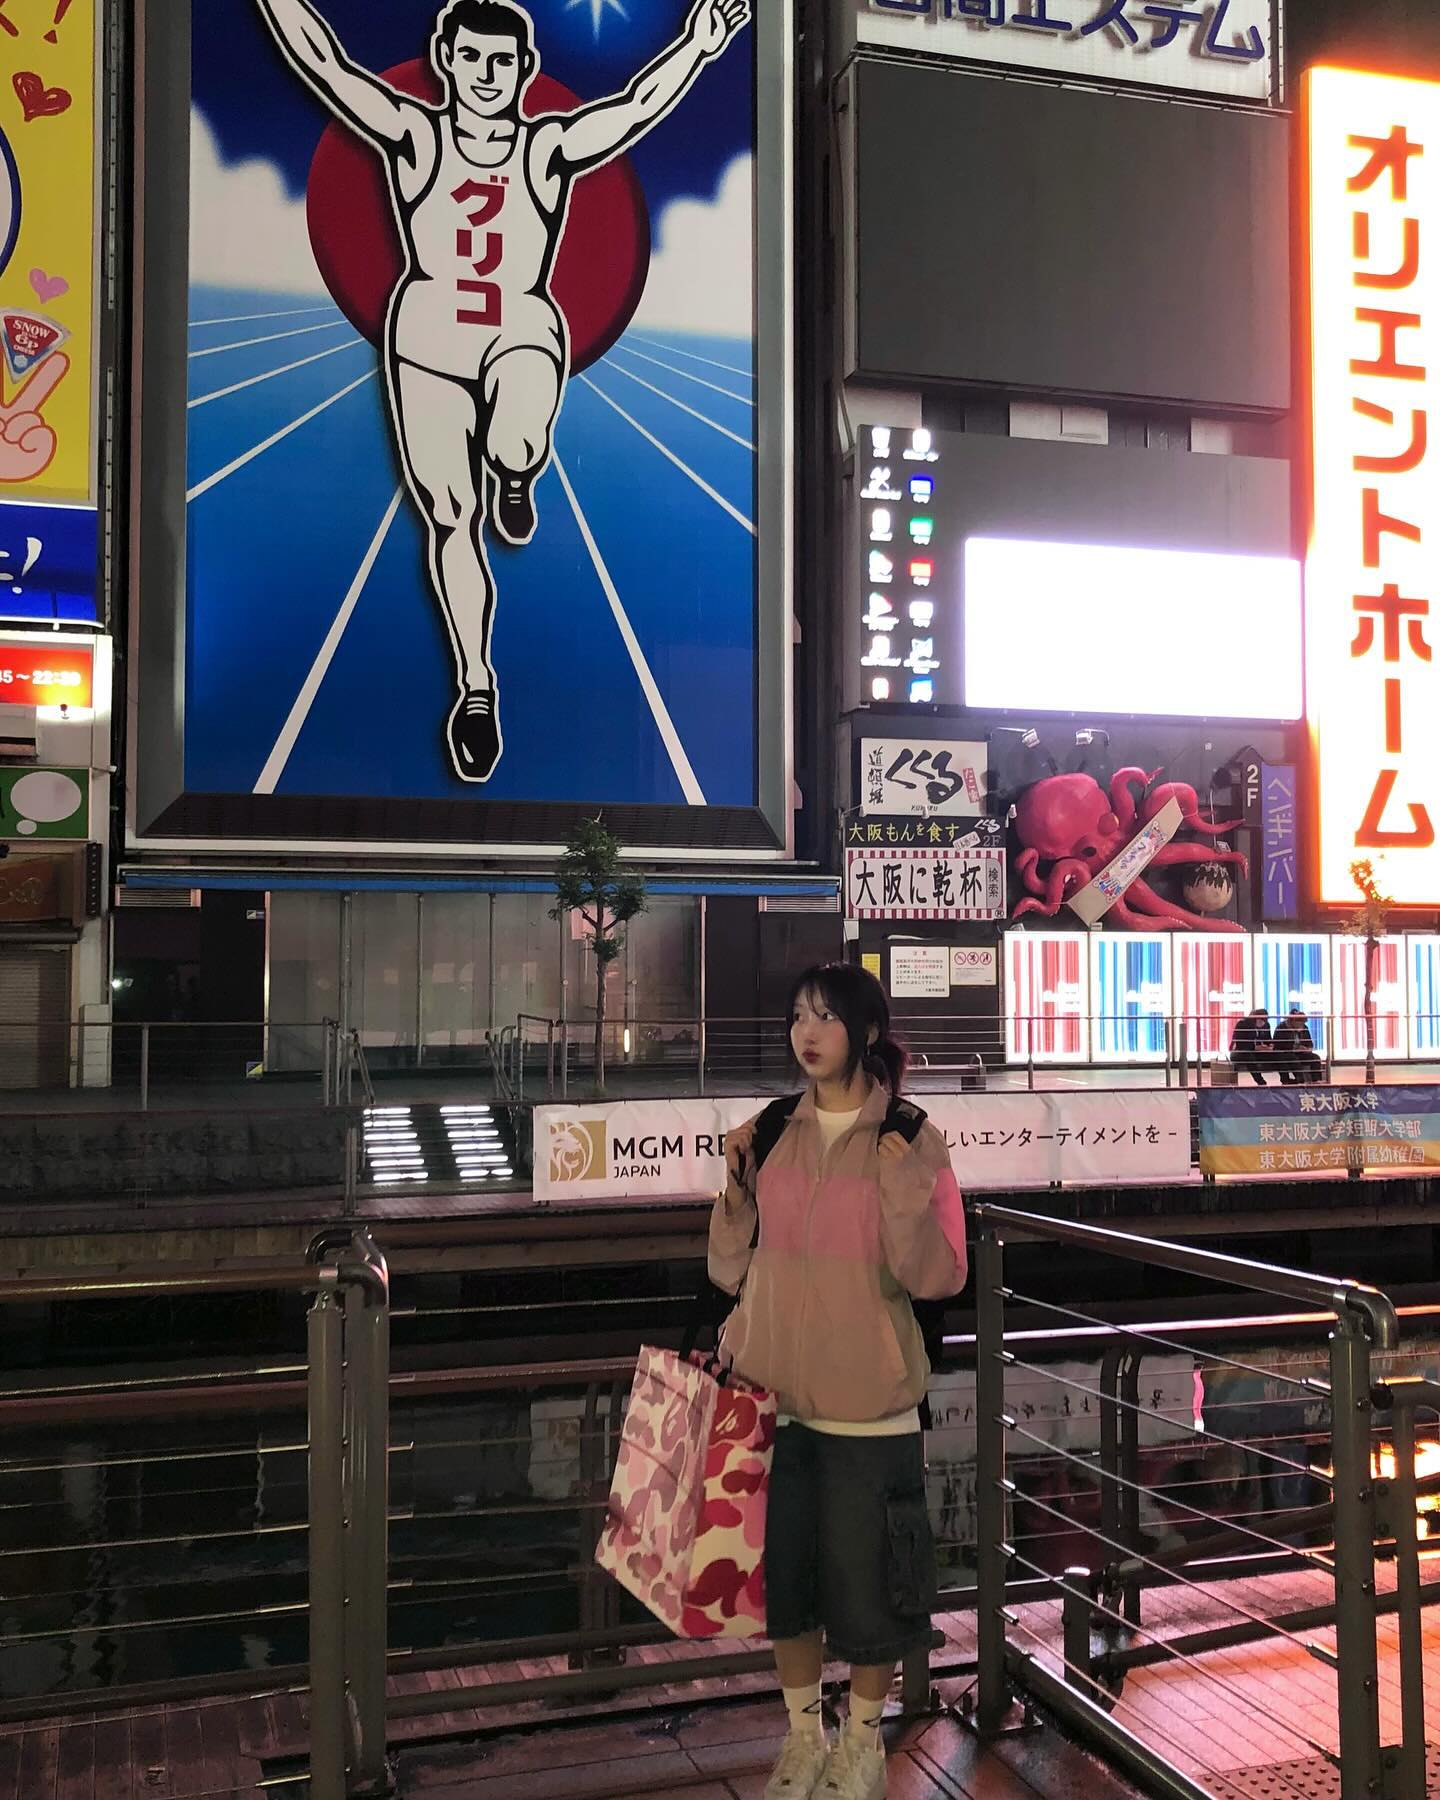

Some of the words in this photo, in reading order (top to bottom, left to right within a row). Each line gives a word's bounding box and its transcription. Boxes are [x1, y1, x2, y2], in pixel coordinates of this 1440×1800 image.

[451, 175, 509, 327] グリコ
[13, 319, 50, 338] SNOW
[1346, 125, 1435, 848] オリエントホーム
[884, 748, 964, 804] くくる
[1246, 764, 1259, 808] 2F
[848, 822, 960, 842] 大阪もんを食す
[983, 835, 1001, 847] 2F
[855, 860, 982, 908] 大阪に乾杯
[988, 867, 999, 898] 検索
[1299, 1092, 1379, 1112] 東大阪大学
[1258, 1119, 1422, 1142] 東大阪大学短期大学部
[613, 1135, 683, 1160] MGM
[1258, 1145, 1425, 1169] 東大阪大学附属幼稚園
[614, 1164, 661, 1178] JAPAN
